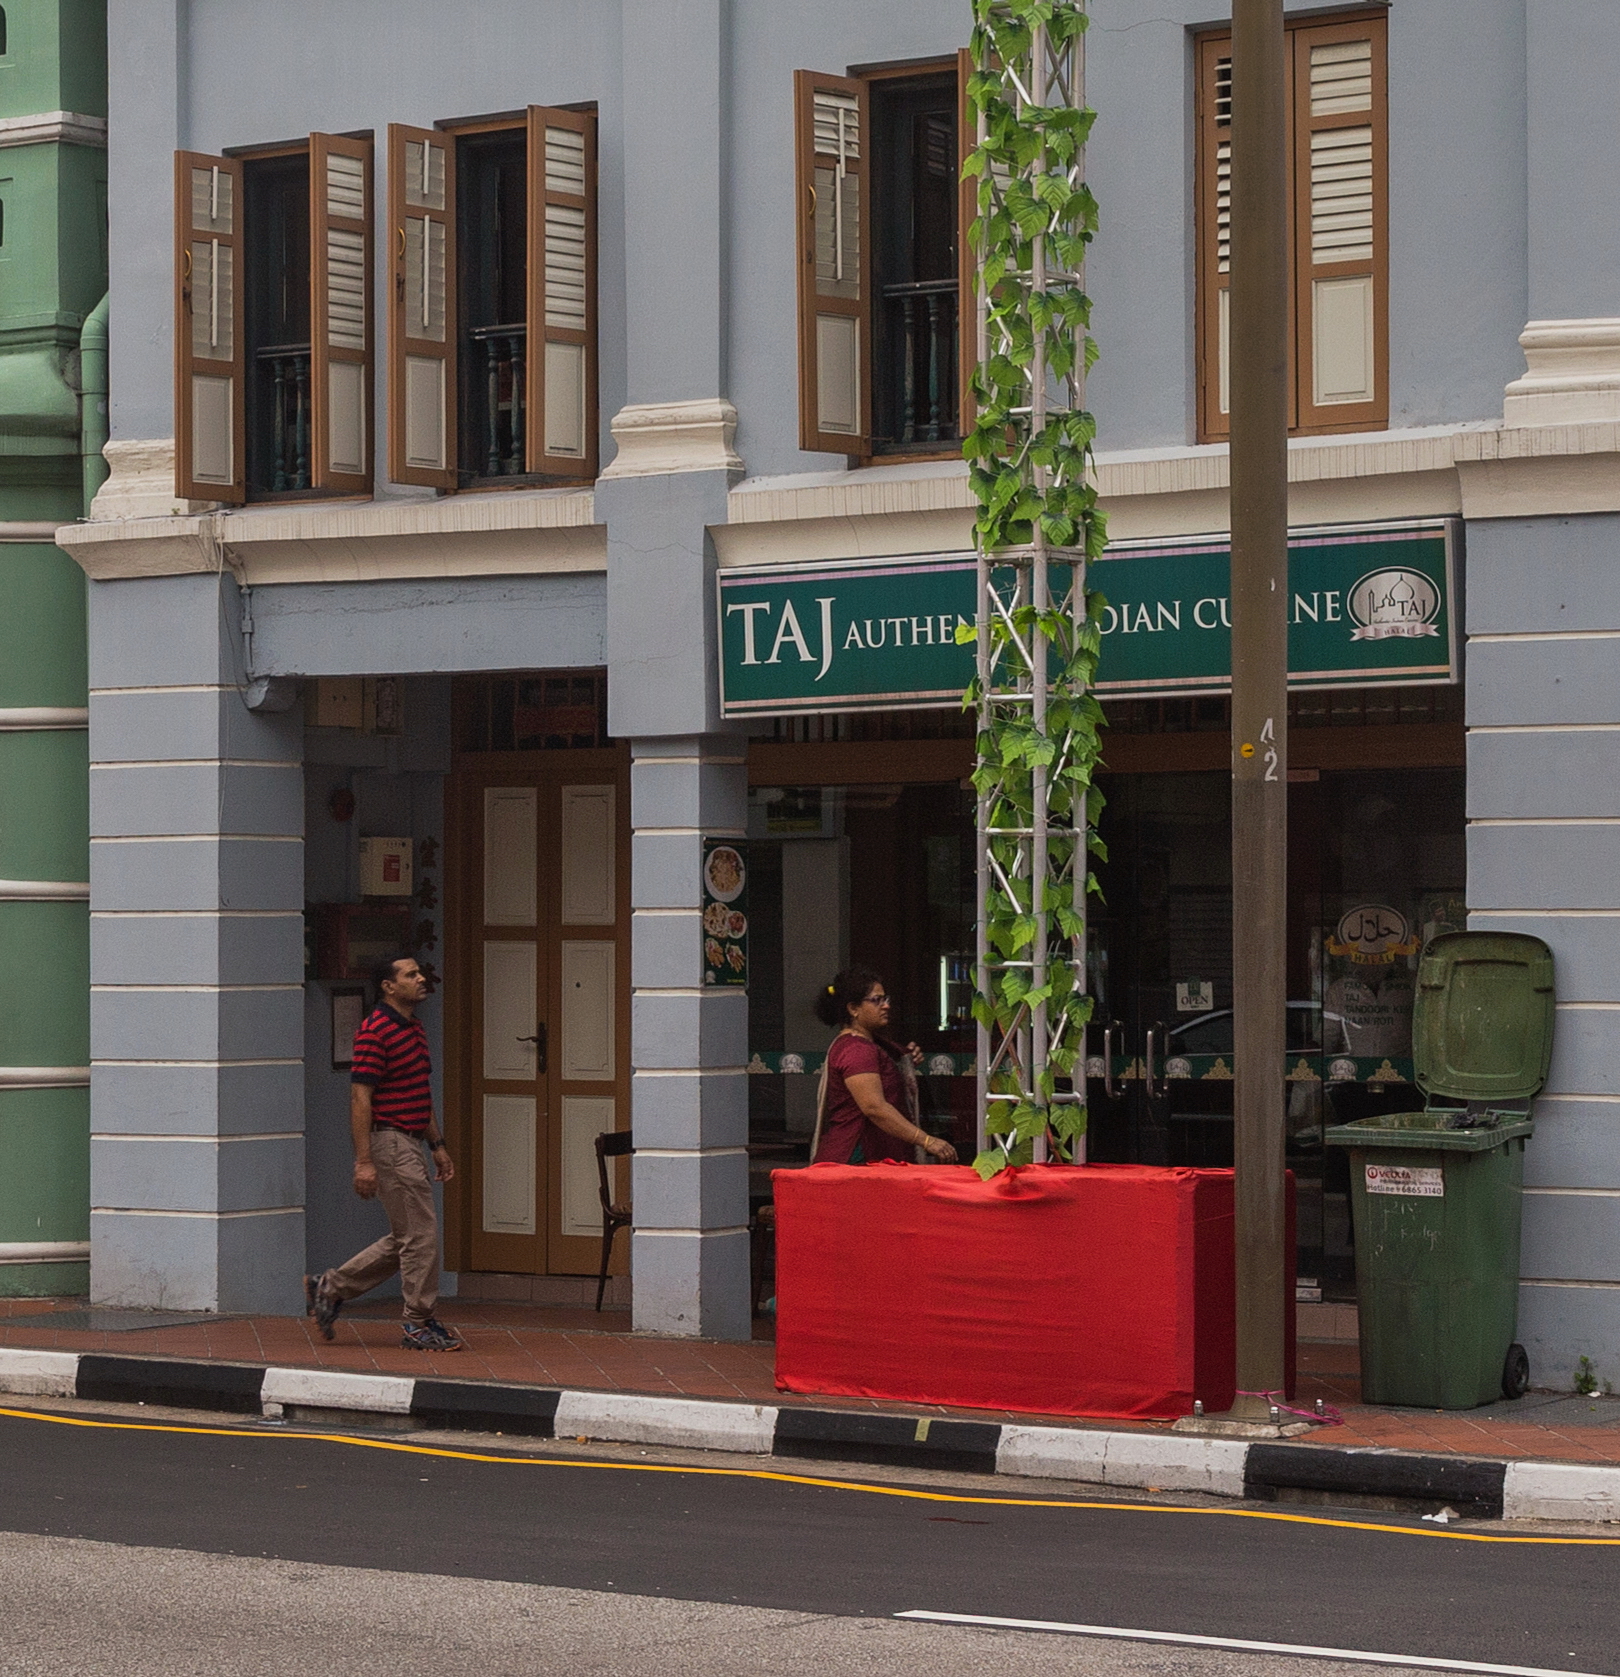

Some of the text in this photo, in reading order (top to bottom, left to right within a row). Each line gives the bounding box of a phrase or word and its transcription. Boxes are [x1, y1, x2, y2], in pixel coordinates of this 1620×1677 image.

[1397, 599, 1426, 619] TAJ
[726, 597, 836, 682] TAJ
[1192, 591, 1341, 629] CUNE
[1348, 913, 1400, 943] حلال
[1353, 951, 1392, 963] HALAL
[1181, 996, 1209, 1005] OPEN
[1367, 1183, 1442, 1195] Hotline 6865 3140
